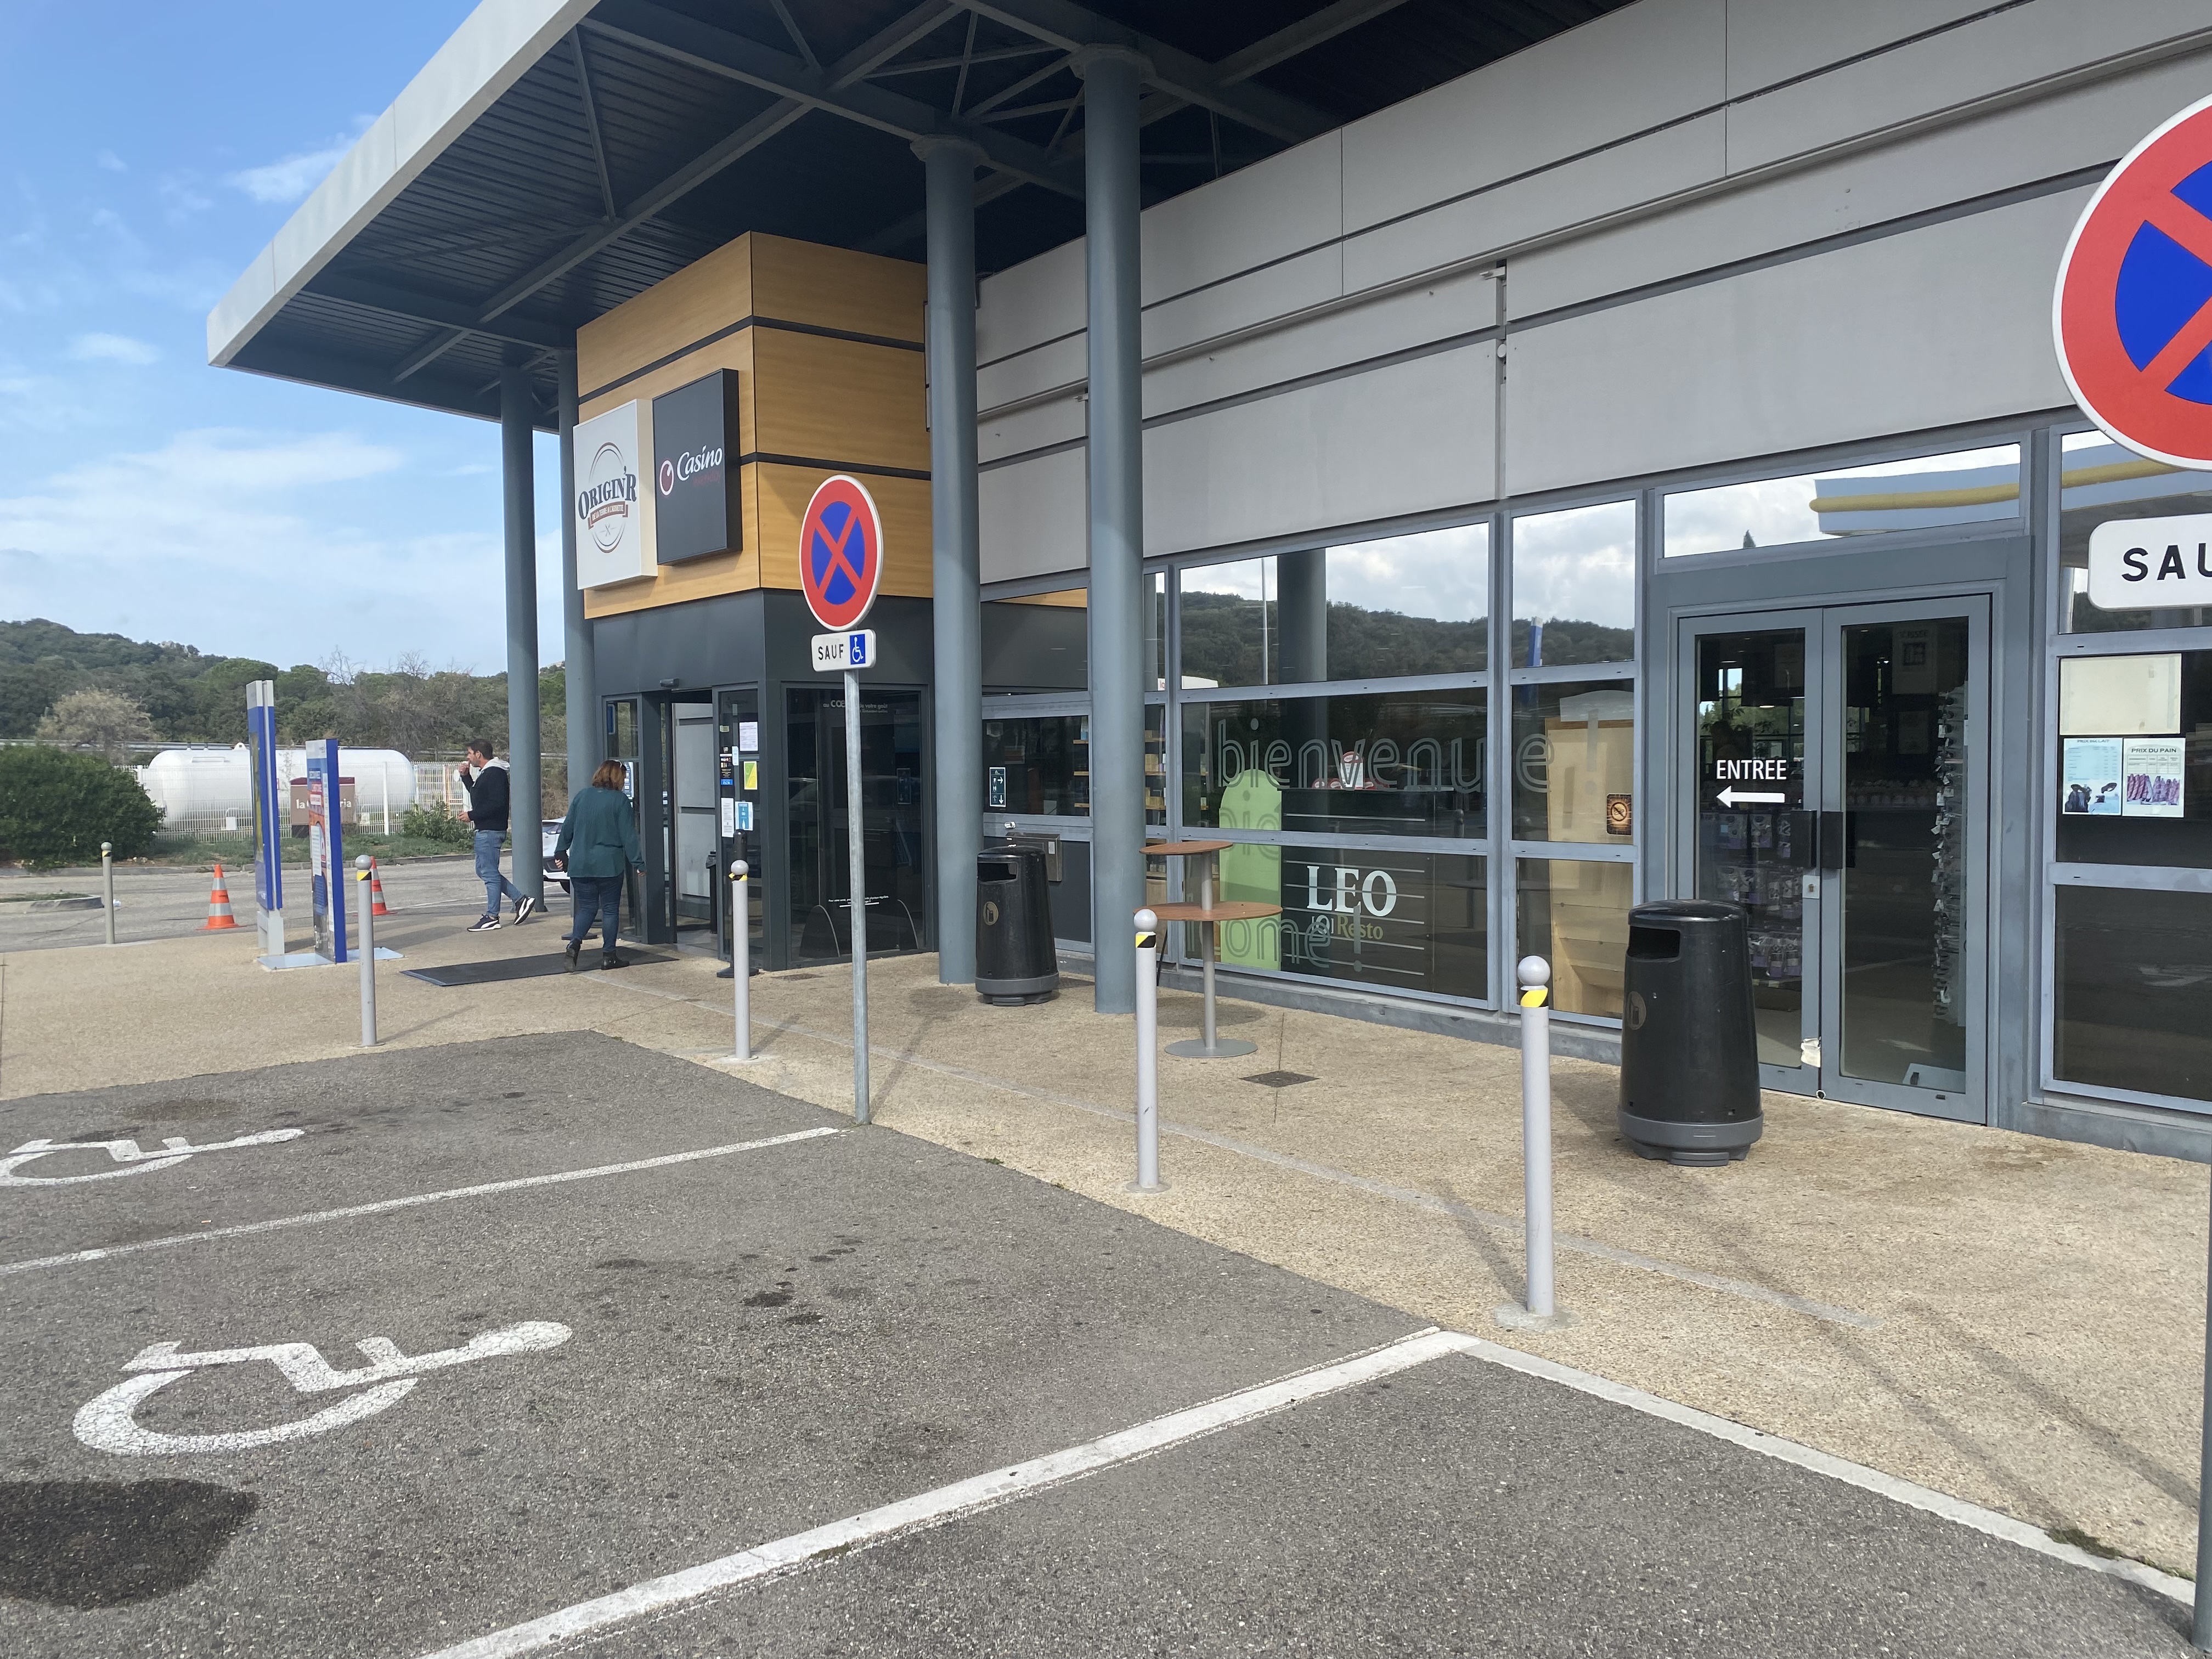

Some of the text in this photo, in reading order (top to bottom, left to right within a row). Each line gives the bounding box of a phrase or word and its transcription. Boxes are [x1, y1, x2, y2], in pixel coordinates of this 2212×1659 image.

[676, 444, 723, 481] Casino
[818, 644, 844, 661] SAUF
[1217, 718, 1555, 794] bienvenue
[1716, 759, 1787, 780] ENTREE
[1307, 865, 1397, 917] LEO
[1336, 913, 1384, 940] Resto
